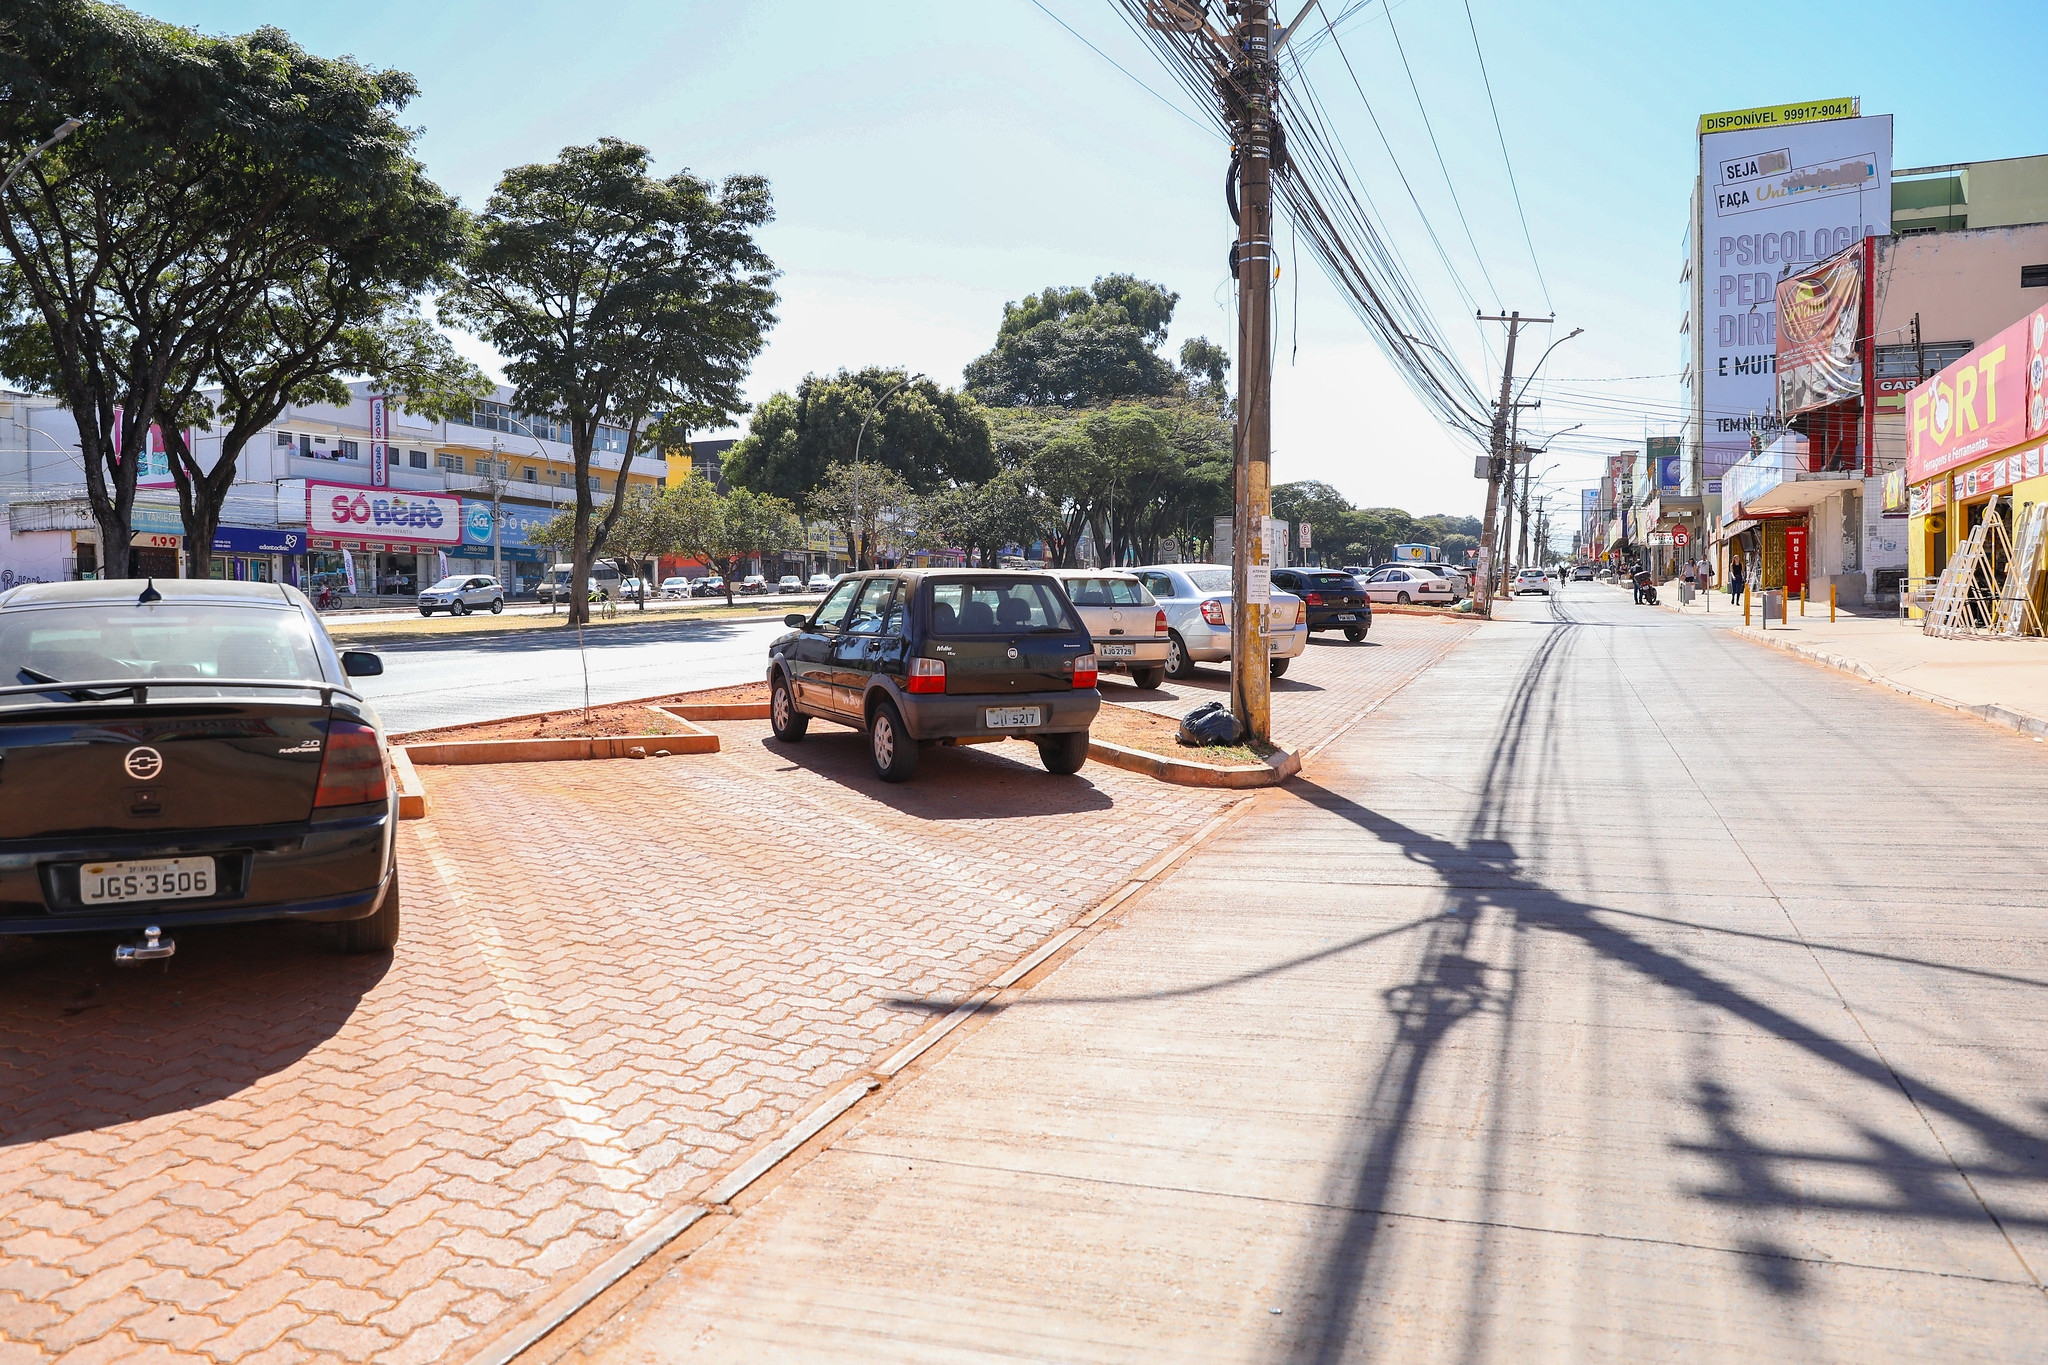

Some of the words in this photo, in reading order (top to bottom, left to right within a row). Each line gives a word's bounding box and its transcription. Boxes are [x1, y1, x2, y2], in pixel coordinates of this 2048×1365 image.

[1706, 111, 1778, 130] DISPONÍVEL
[1784, 103, 1848, 121] 99917-9041
[1726, 161, 1758, 180] SEJA
[1718, 190, 1750, 209] FAÇA
[1718, 357, 1728, 377] E
[1913, 345, 2006, 457] FORT
[1716, 417, 1741, 433] TEM
[1952, 437, 1989, 460] Ferramentas
[366, 526, 391, 534] PRODUTOS
[259, 543, 289, 551] odontoclinic
